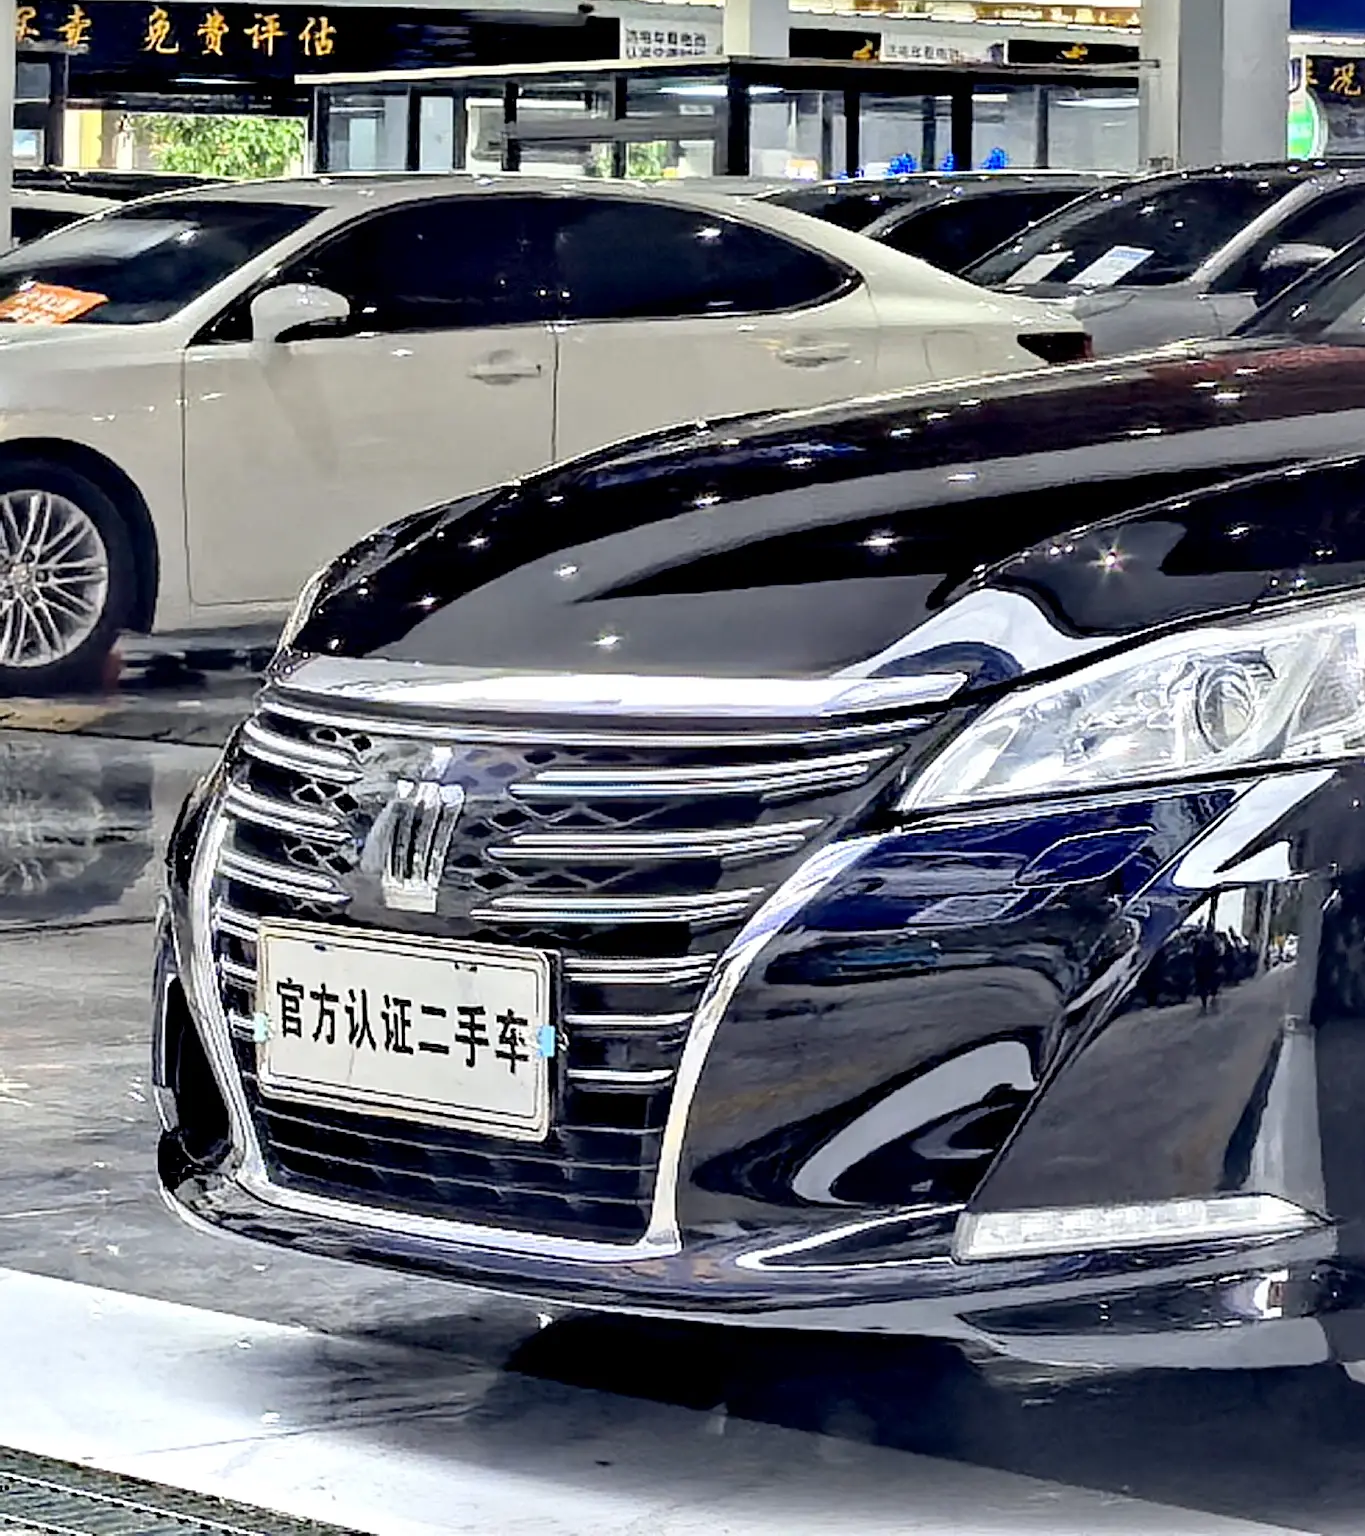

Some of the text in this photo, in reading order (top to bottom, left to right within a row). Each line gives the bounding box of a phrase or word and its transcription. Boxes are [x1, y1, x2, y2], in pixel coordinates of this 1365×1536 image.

[276, 977, 529, 1075] 官方认证二手车
